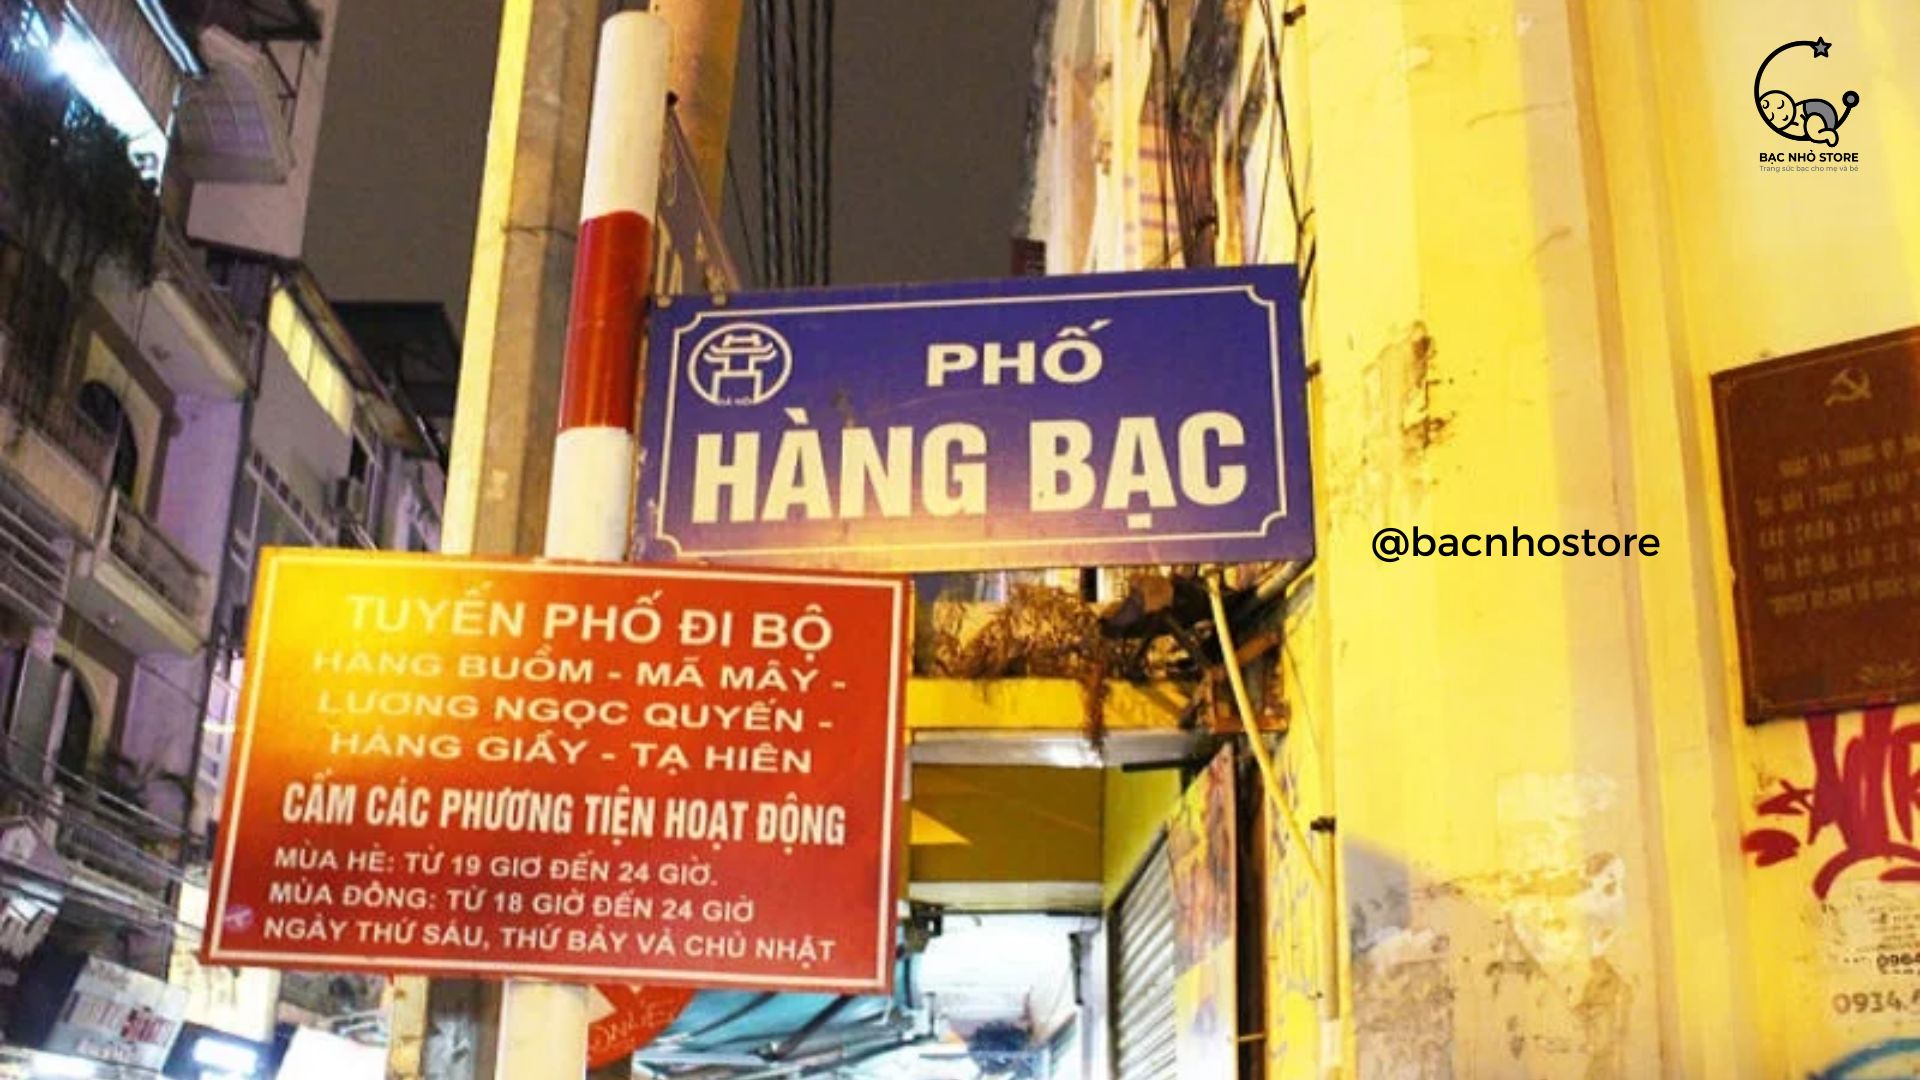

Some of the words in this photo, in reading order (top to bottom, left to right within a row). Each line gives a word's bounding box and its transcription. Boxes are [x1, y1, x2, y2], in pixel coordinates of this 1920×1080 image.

[927, 319, 1112, 388] PHỐ
[692, 407, 988, 524] HÀNG
[1030, 411, 1248, 530] BẠC
[346, 580, 526, 639] TUYẾN
[543, 590, 663, 643] PHỐ
[679, 608, 732, 648] ĐI
[752, 603, 833, 662] BỘ
[636, 656, 704, 688] MÃ
[719, 659, 819, 692] MÂY
[494, 695, 629, 730] NGỌC
[631, 742, 689, 776] TẠ
[283, 768, 356, 825] CẤM
[366, 776, 431, 828] CÁC
[439, 786, 573, 834] PHƯƠNG
[585, 784, 656, 846] TIỆN
[664, 797, 749, 851] HOẠT
[756, 791, 846, 856] ĐỘNG
[274, 839, 338, 870] MÙA
[451, 855, 481, 877] 19
[550, 849, 610, 882] ĐẾN
[618, 862, 651, 884] 24
[342, 880, 436, 910] ĐÔNG:
[494, 892, 523, 914] 18
[592, 888, 653, 919] ĐẾN
[661, 899, 693, 920] 24
[755, 935, 836, 969] NHẬT
